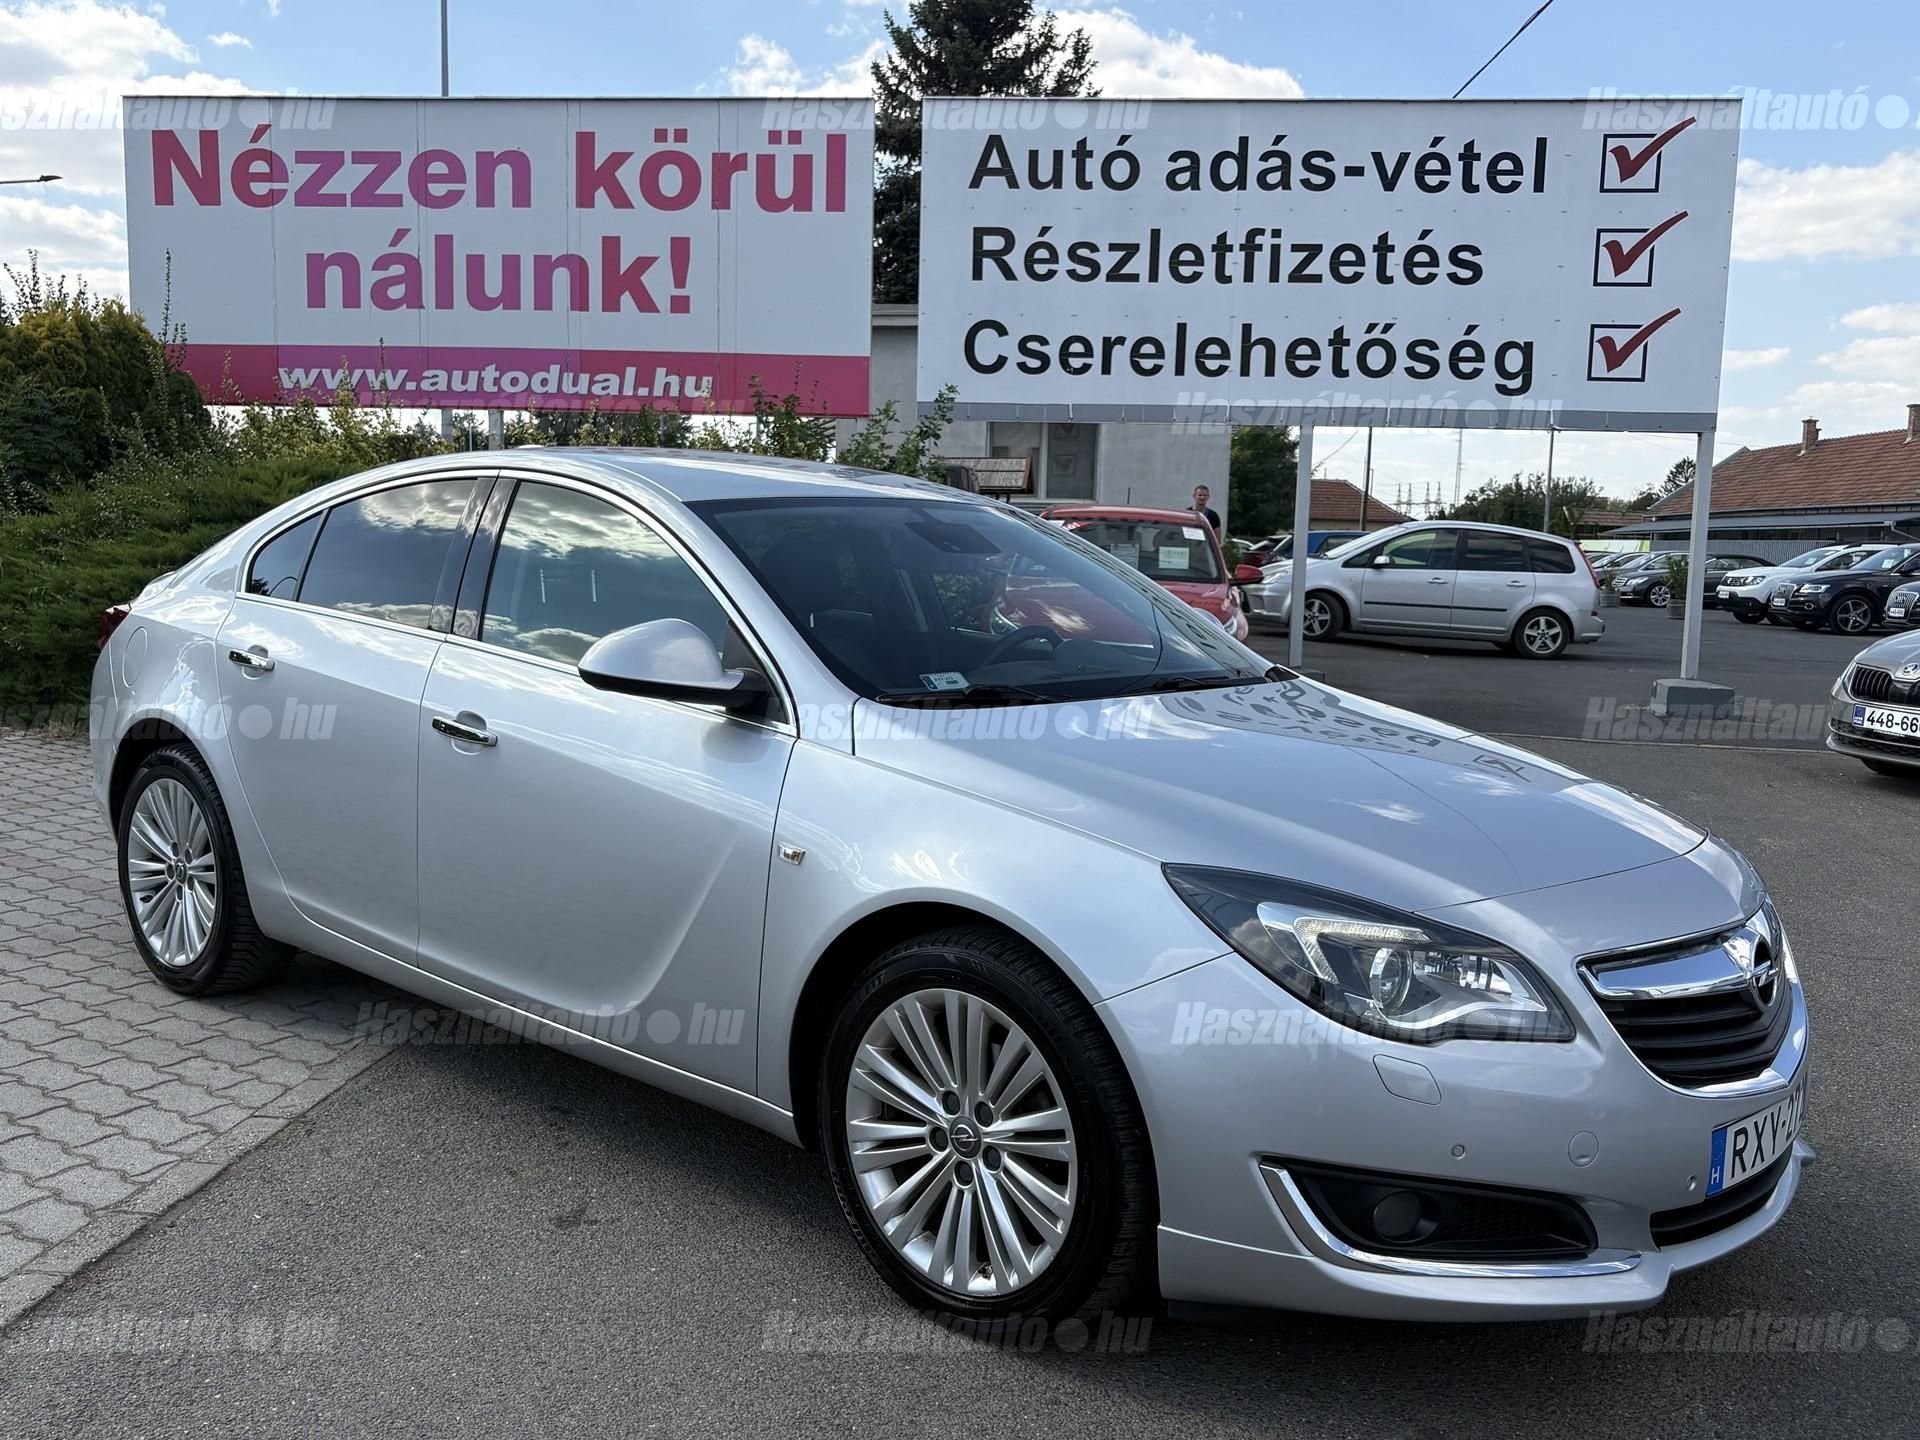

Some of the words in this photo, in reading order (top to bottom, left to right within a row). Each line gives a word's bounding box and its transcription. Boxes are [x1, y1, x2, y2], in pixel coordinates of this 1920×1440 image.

[152, 125, 532, 209] Nézzen
[576, 128, 847, 213] körül
[968, 134, 1142, 192] Autó
[1165, 135, 1548, 195] adás-vétel
[306, 228, 692, 314] nálunk!
[972, 225, 1484, 287] Részletfizetés
[279, 363, 713, 399] www.autodual.hu
[963, 319, 1535, 397] Cserelehetőség
[1866, 710, 1920, 734] 448-66
[1711, 1166, 1720, 1185] H
